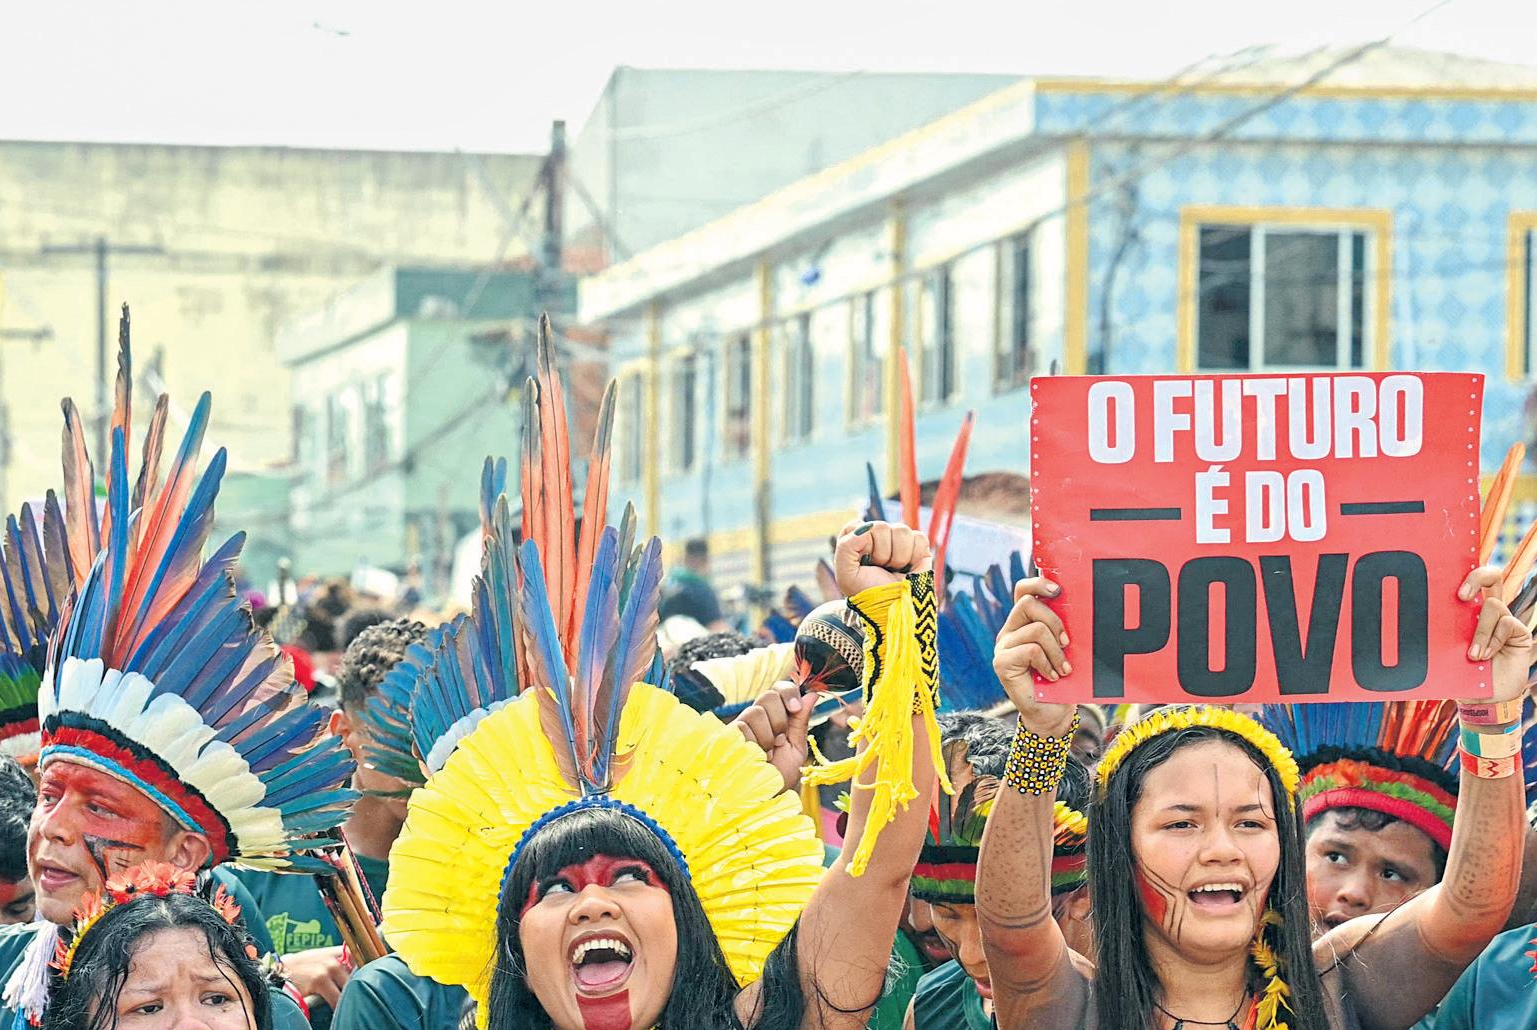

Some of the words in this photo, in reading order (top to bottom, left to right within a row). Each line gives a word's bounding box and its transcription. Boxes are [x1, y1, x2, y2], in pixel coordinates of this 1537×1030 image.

[1087, 381, 1135, 464] O
[1154, 375, 1424, 463] FUTURO
[1194, 465, 1231, 544] É
[1246, 469, 1327, 543] DO
[1092, 550, 1429, 699] POVO
